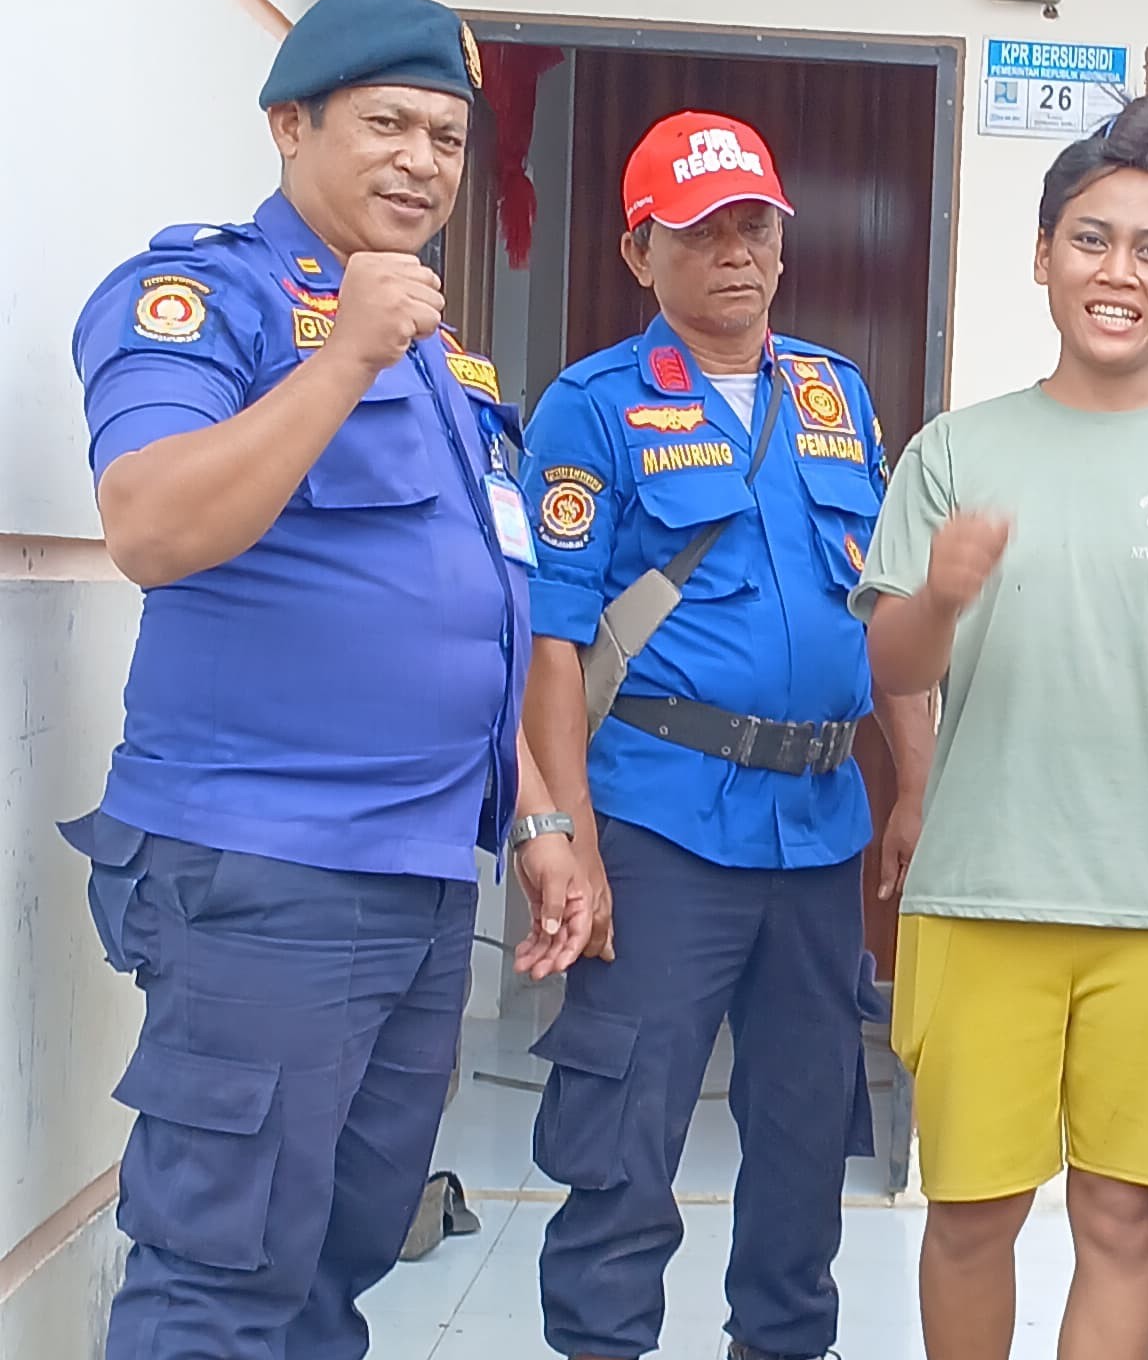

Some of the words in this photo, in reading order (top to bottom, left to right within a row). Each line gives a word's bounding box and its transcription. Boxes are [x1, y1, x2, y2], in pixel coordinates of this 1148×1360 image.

[1000, 43, 1029, 65] KPR
[1032, 44, 1113, 71] BERSUBSIDI
[991, 65, 1039, 77] PEMERINTAH
[1041, 67, 1078, 80] REPUBLIK
[1040, 84, 1072, 111] 26
[643, 442, 733, 475] MANURUNG
[796, 433, 864, 464] PEMADAM
